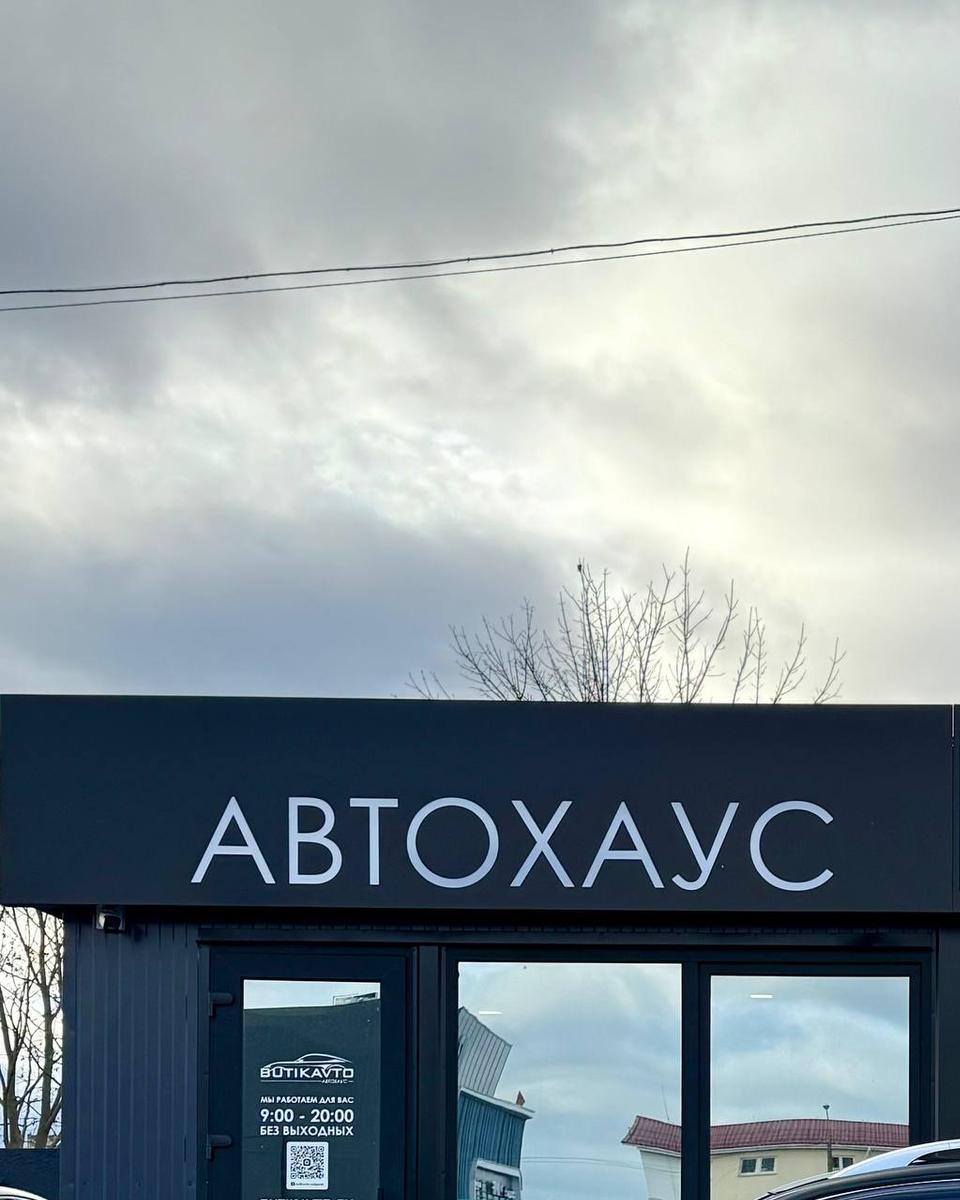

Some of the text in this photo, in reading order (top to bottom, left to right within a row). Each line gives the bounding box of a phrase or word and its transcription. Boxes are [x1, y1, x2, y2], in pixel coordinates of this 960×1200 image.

[191, 797, 834, 891] АВТОХАУС
[260, 1068, 354, 1078] BUTIKAVTO
[260, 1096, 354, 1104] МЫ РАБОТАЕМ ДЛЯ ВАС
[260, 1108, 294, 1123] 9:00
[310, 1108, 354, 1123] 20:00
[260, 1126, 354, 1137] БЕЗ ВЫХОДНЫХ
